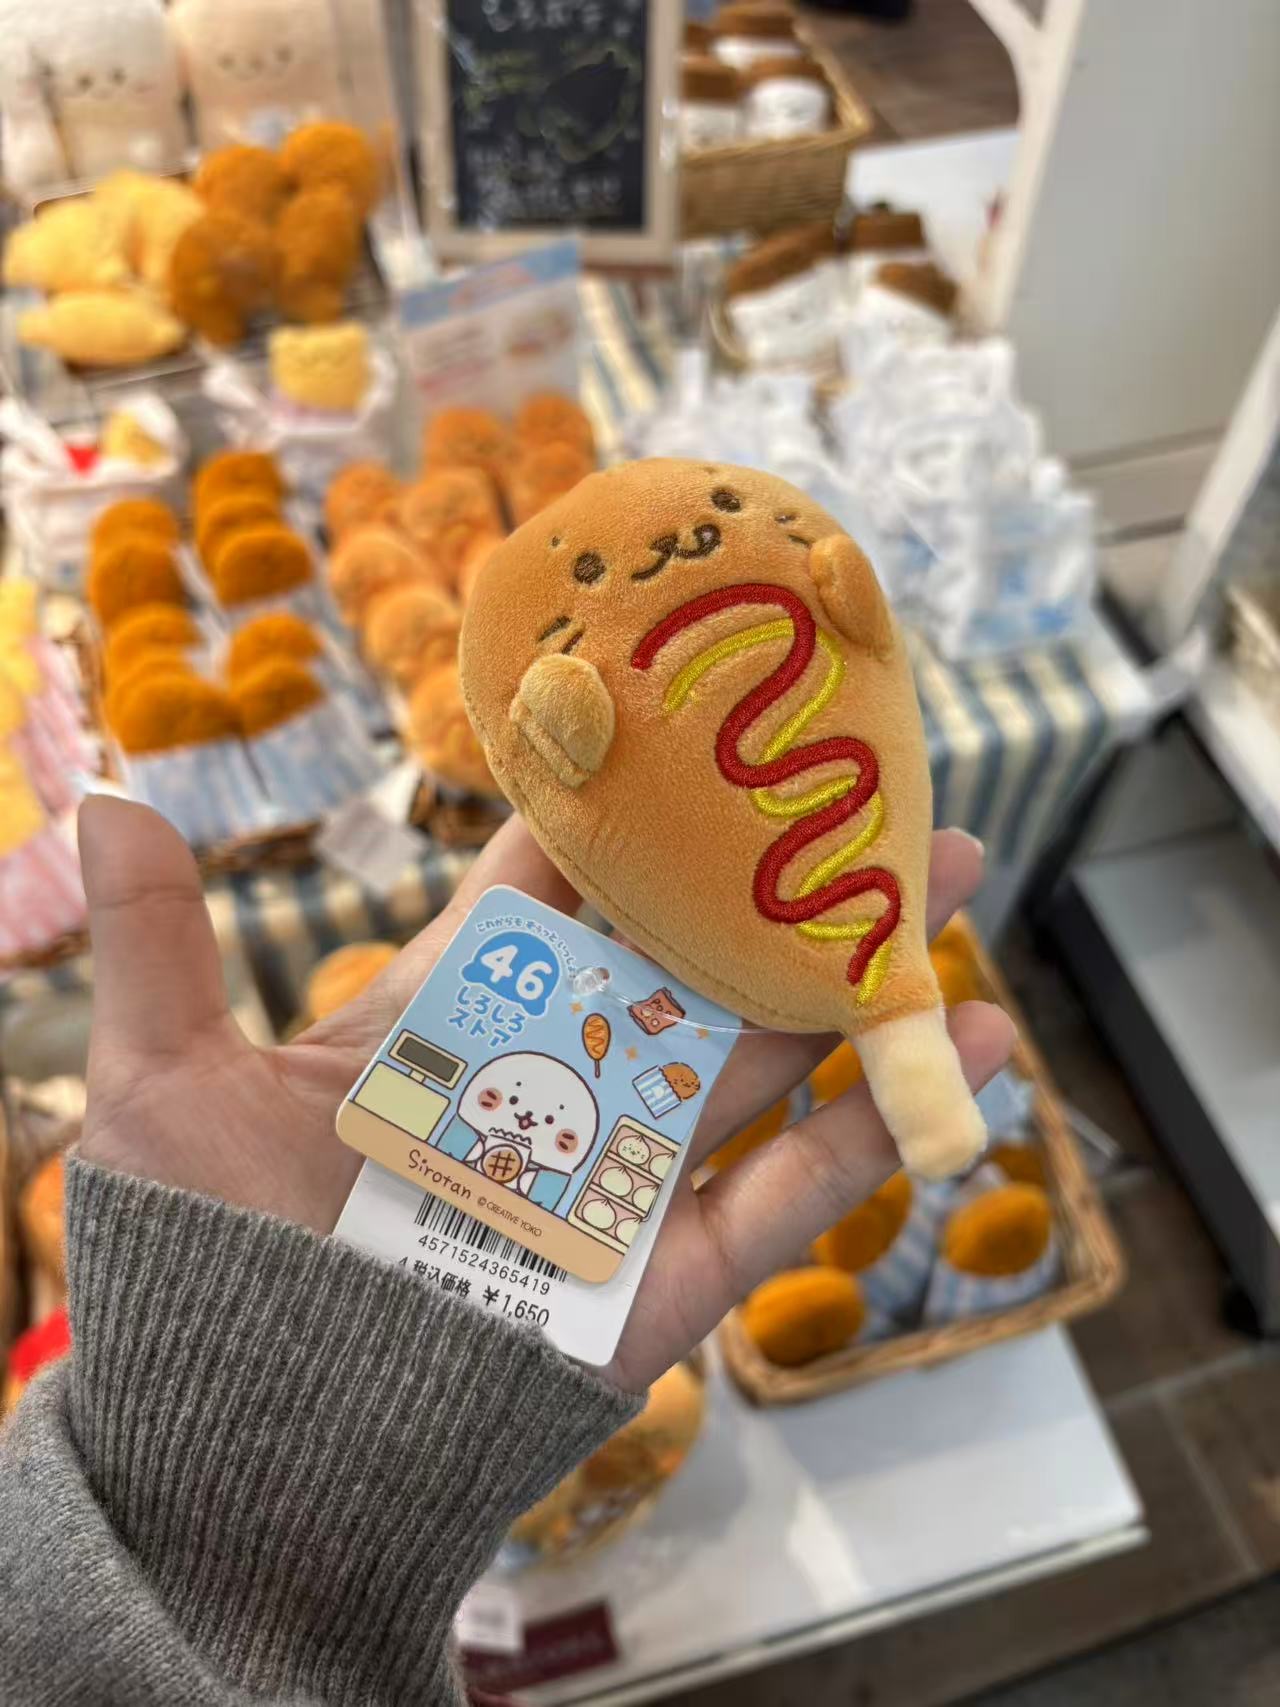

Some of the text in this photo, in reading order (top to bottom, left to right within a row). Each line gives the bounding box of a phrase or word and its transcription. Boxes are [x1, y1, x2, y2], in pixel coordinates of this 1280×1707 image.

[480, 944, 553, 1001] 46
[448, 1007, 513, 1047] ストア
[457, 985, 526, 1033] しろしろ
[408, 1149, 472, 1200] Sirotan
[519, 1219, 543, 1238] YOKO
[418, 1234, 551, 1296] 4571524365419
